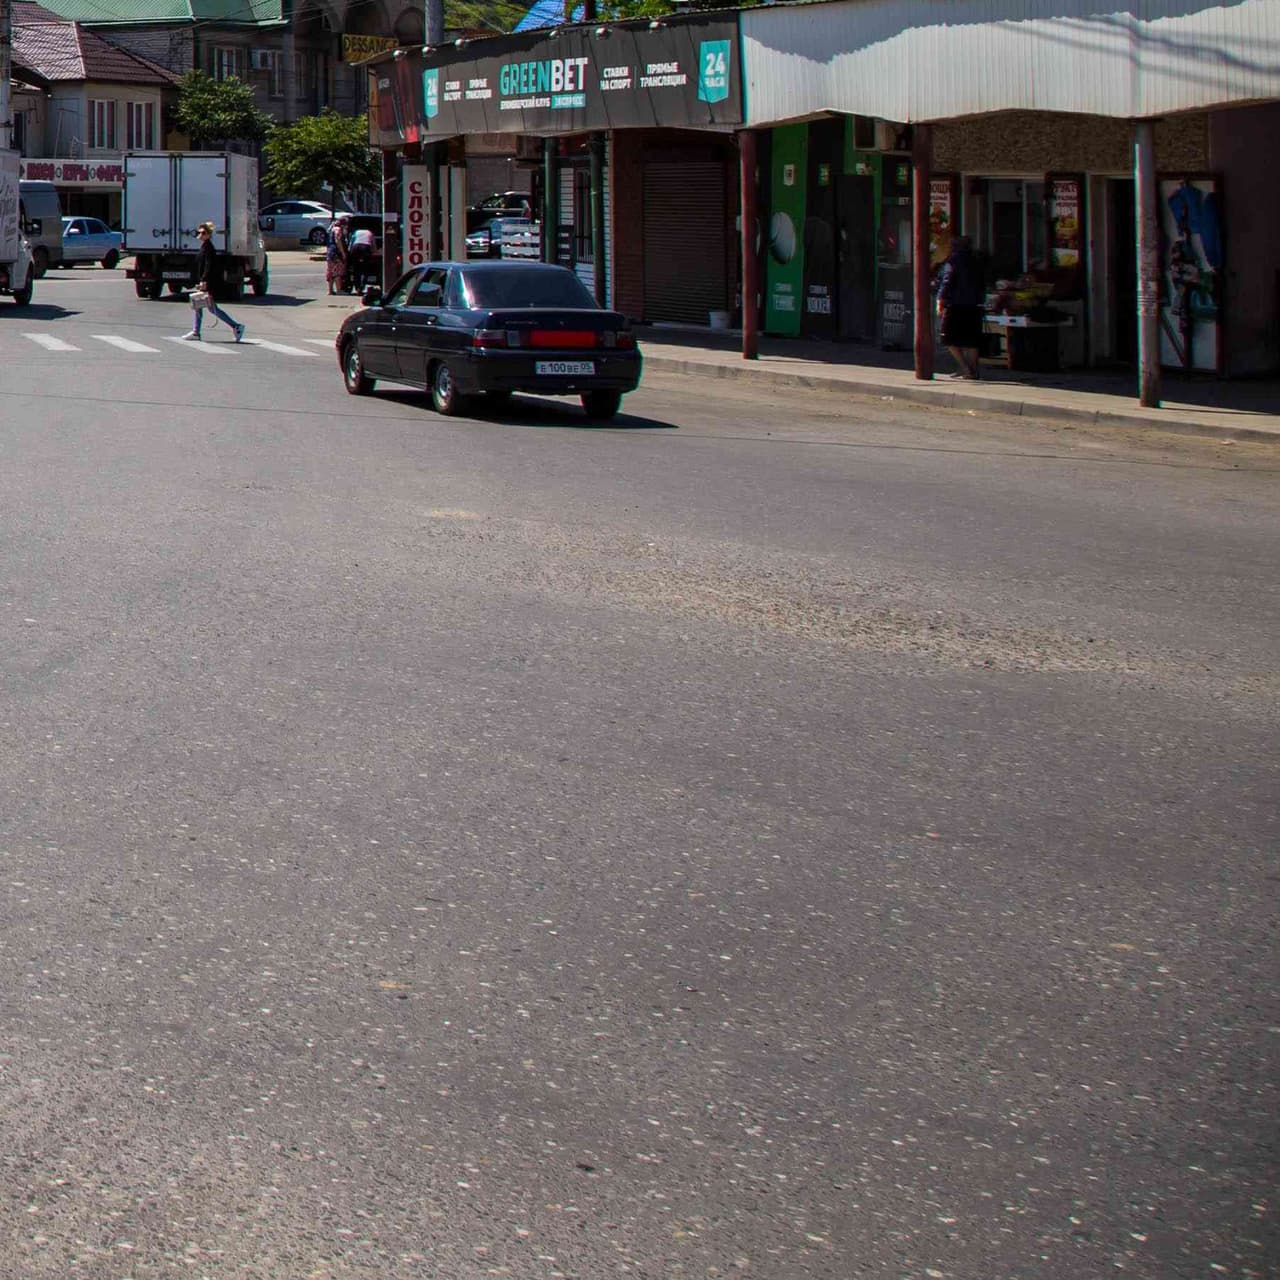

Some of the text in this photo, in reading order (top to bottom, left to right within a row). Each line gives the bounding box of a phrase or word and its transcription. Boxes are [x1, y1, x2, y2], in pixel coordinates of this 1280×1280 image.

[603, 66, 629, 78] СТАВКИ
[646, 61, 678, 75] ПРЯМЫЕ
[705, 52, 726, 75] 24
[499, 56, 589, 97] GREENBET
[408, 181, 424, 266] СЛОЕНО
